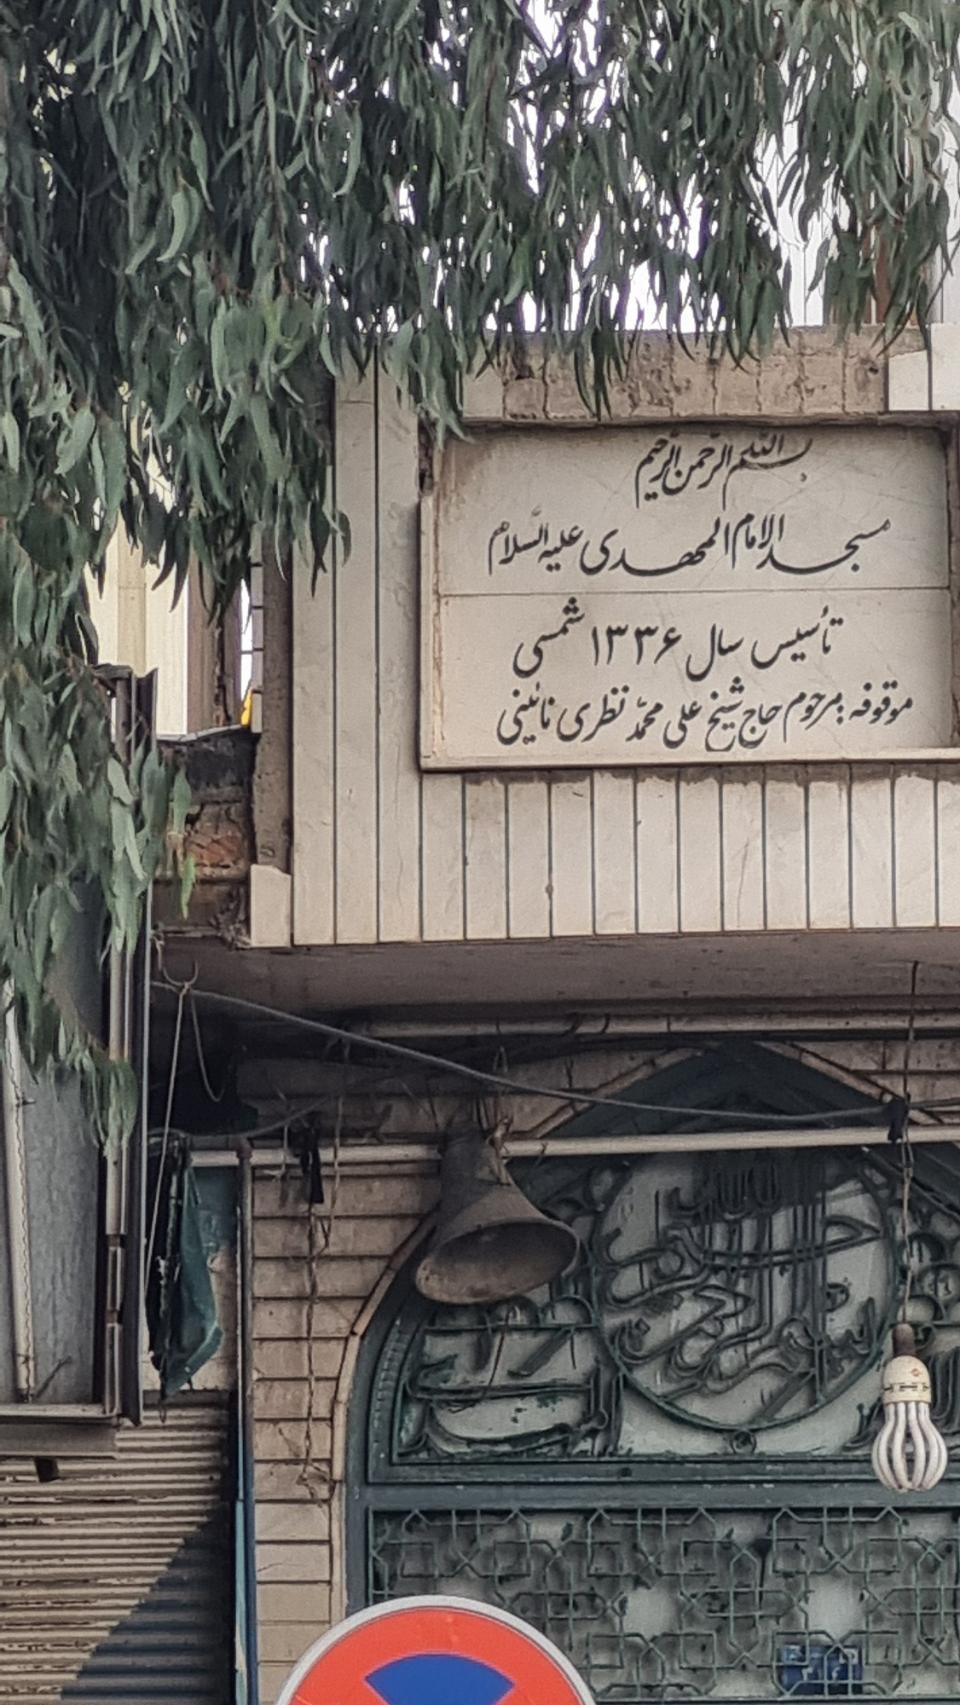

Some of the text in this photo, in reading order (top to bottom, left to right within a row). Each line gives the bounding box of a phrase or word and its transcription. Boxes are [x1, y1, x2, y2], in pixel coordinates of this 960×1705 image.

[661, 431, 734, 496] الرحمن
[537, 525, 585, 572] علیه
[579, 516, 730, 577] المهدی
[755, 518, 891, 575] مسجد
[512, 596, 586, 679] شمسی
[591, 624, 683, 667] ۱۳۳۶
[685, 623, 744, 682] سال
[556, 685, 630, 743] نظری
[663, 700, 703, 750] علی
[704, 676, 745, 752] شیخ
[737, 703, 783, 750] حاج
[783, 691, 843, 744] مرحوم
